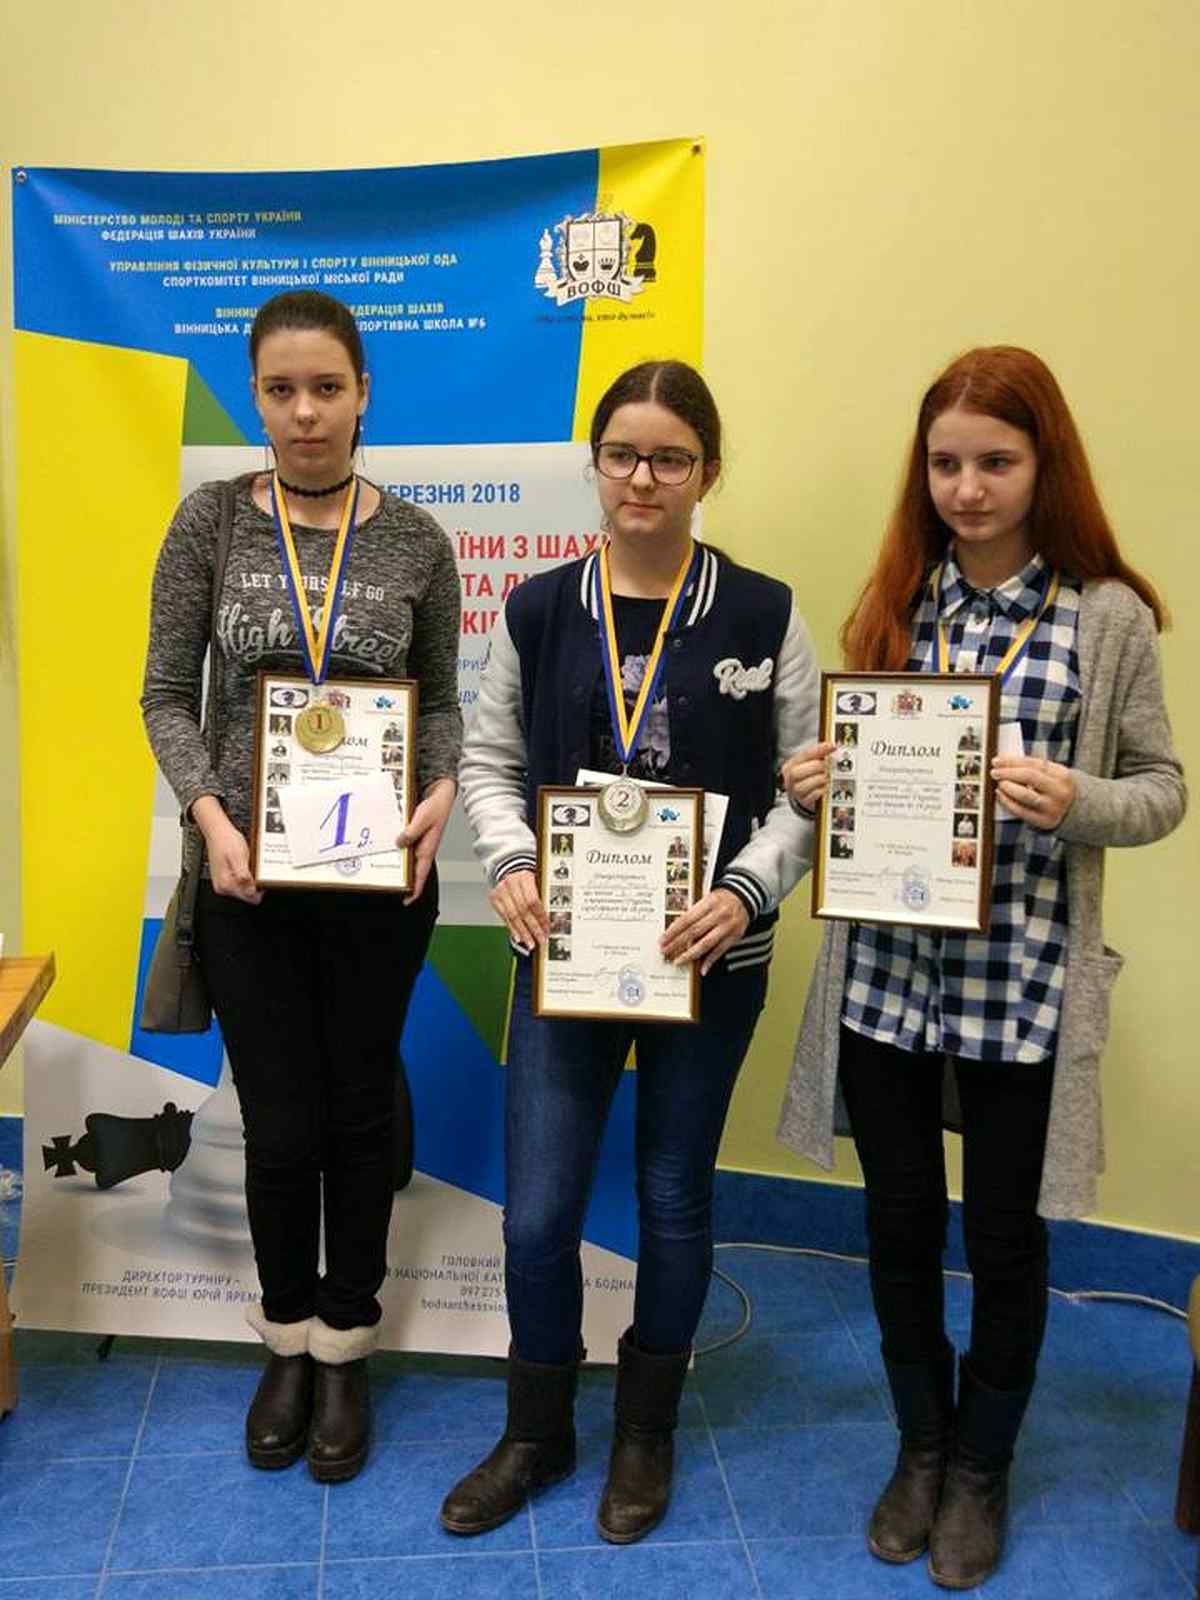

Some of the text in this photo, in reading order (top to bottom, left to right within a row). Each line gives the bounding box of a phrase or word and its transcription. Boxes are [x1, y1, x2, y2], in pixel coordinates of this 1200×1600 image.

[53, 210, 302, 225] МІНІСТЕРСТВО МОЛОДІ ТА СПОРТУ УКРАЇНИ
[101, 228, 257, 241] ФЕДЕРАЦІЯ ШАХІВ УКРАЇНИ
[109, 260, 180, 272] УПРАВЛІННЯ
[184, 259, 238, 271] ФІЗИЧНОЇ
[242, 259, 299, 271] КУЛЬТУРИ
[311, 257, 357, 269] СПОРТУ
[361, 254, 430, 268] ВІННИЦЬКОЇ
[433, 255, 458, 267] ОДА
[163, 271, 405, 287] СПОРТКОМІТЕТ ВІННИЦЬКОЇ МІСЬКОЇ РАДИ
[566, 280, 622, 298] ВОФШ
[350, 304, 404, 316] ЕДЕРАЦІЯ
[408, 303, 444, 314] ШАХІВ
[174, 323, 240, 336] ВІННИЦЬКА
[357, 319, 420, 332] ПОРТИВНА
[424, 317, 464, 330] ШКОЛА
[472, 483, 520, 503] 2018
[536, 533, 610, 559] ШАХ
[240, 572, 272, 589] LET
[366, 585, 384, 601] GO
[461, 573, 494, 597] ТА
[870, 740, 941, 758] Диплом
[616, 791, 630, 808] 2
[319, 792, 354, 852] 1
[586, 849, 652, 865] Диплом
[440, 1254, 500, 1267] ГОЛОВНИЙ
[122, 1269, 184, 1284] ДИРЕКТОР
[81, 1282, 149, 1297] ПРЕЗИДЕНТ
[192, 1287, 221, 1301] ЮРІЙ
